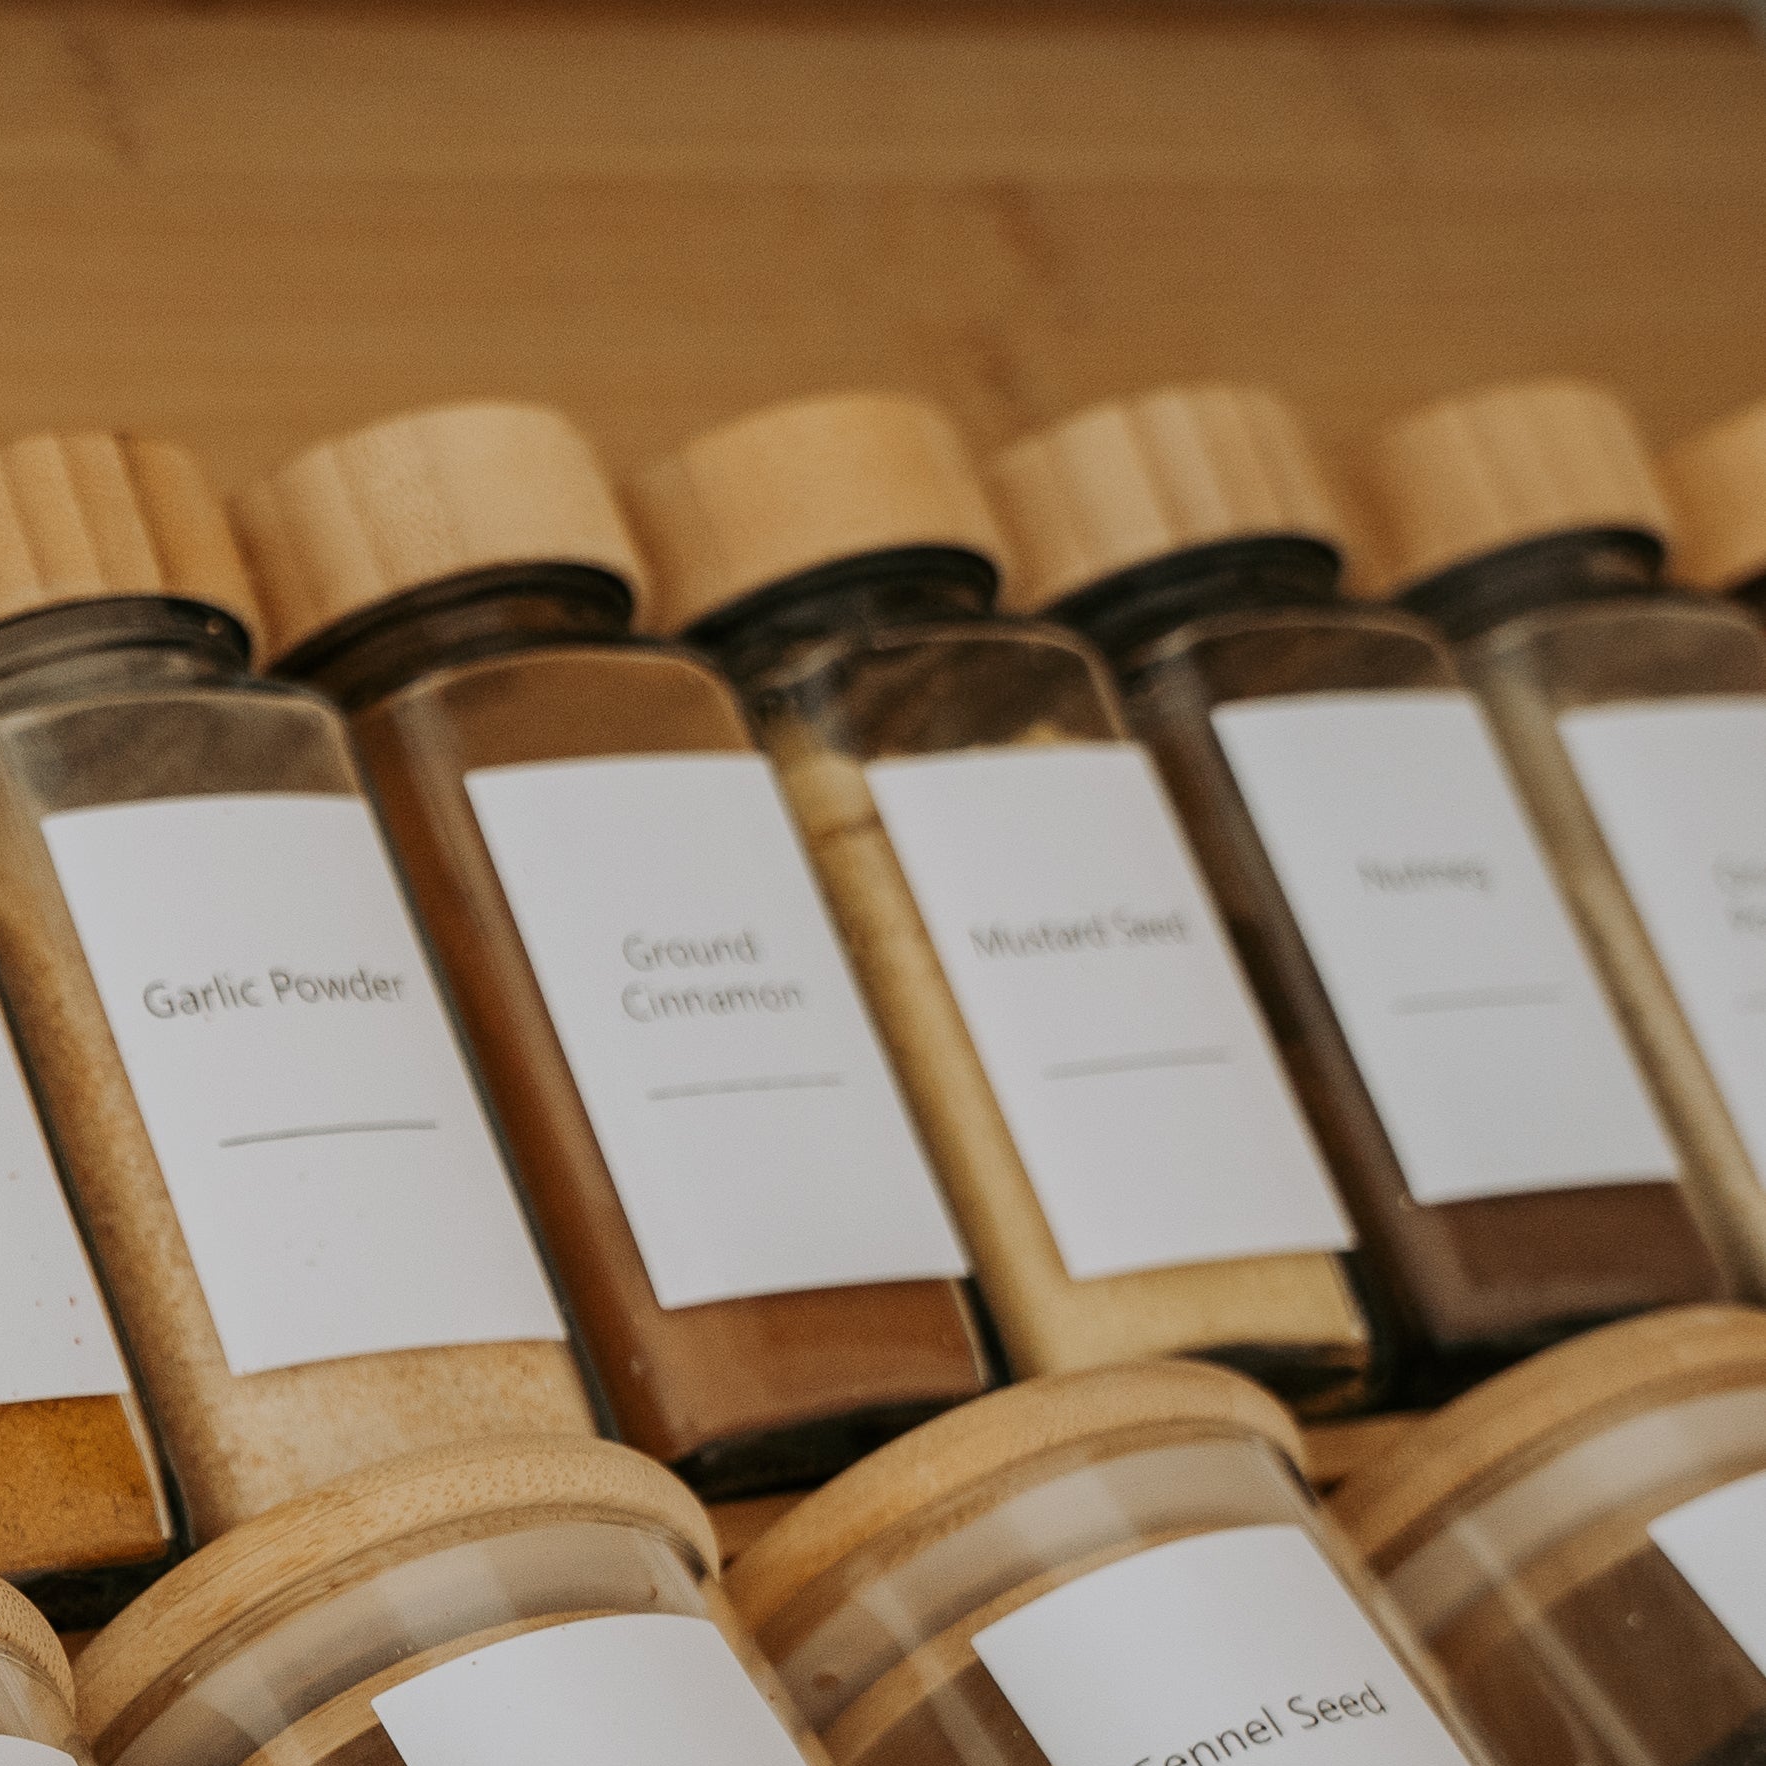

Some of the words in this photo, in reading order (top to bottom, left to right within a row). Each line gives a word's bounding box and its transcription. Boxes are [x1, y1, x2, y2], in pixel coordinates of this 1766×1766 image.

[621, 929, 760, 971] Ground
[970, 912, 1106, 956] Mustard
[1112, 907, 1188, 946] Seed
[143, 969, 257, 1017] Garlic
[270, 968, 404, 1000] Powder
[621, 981, 803, 1022] Cinnamon
[1287, 1684, 1387, 1729] Seed
